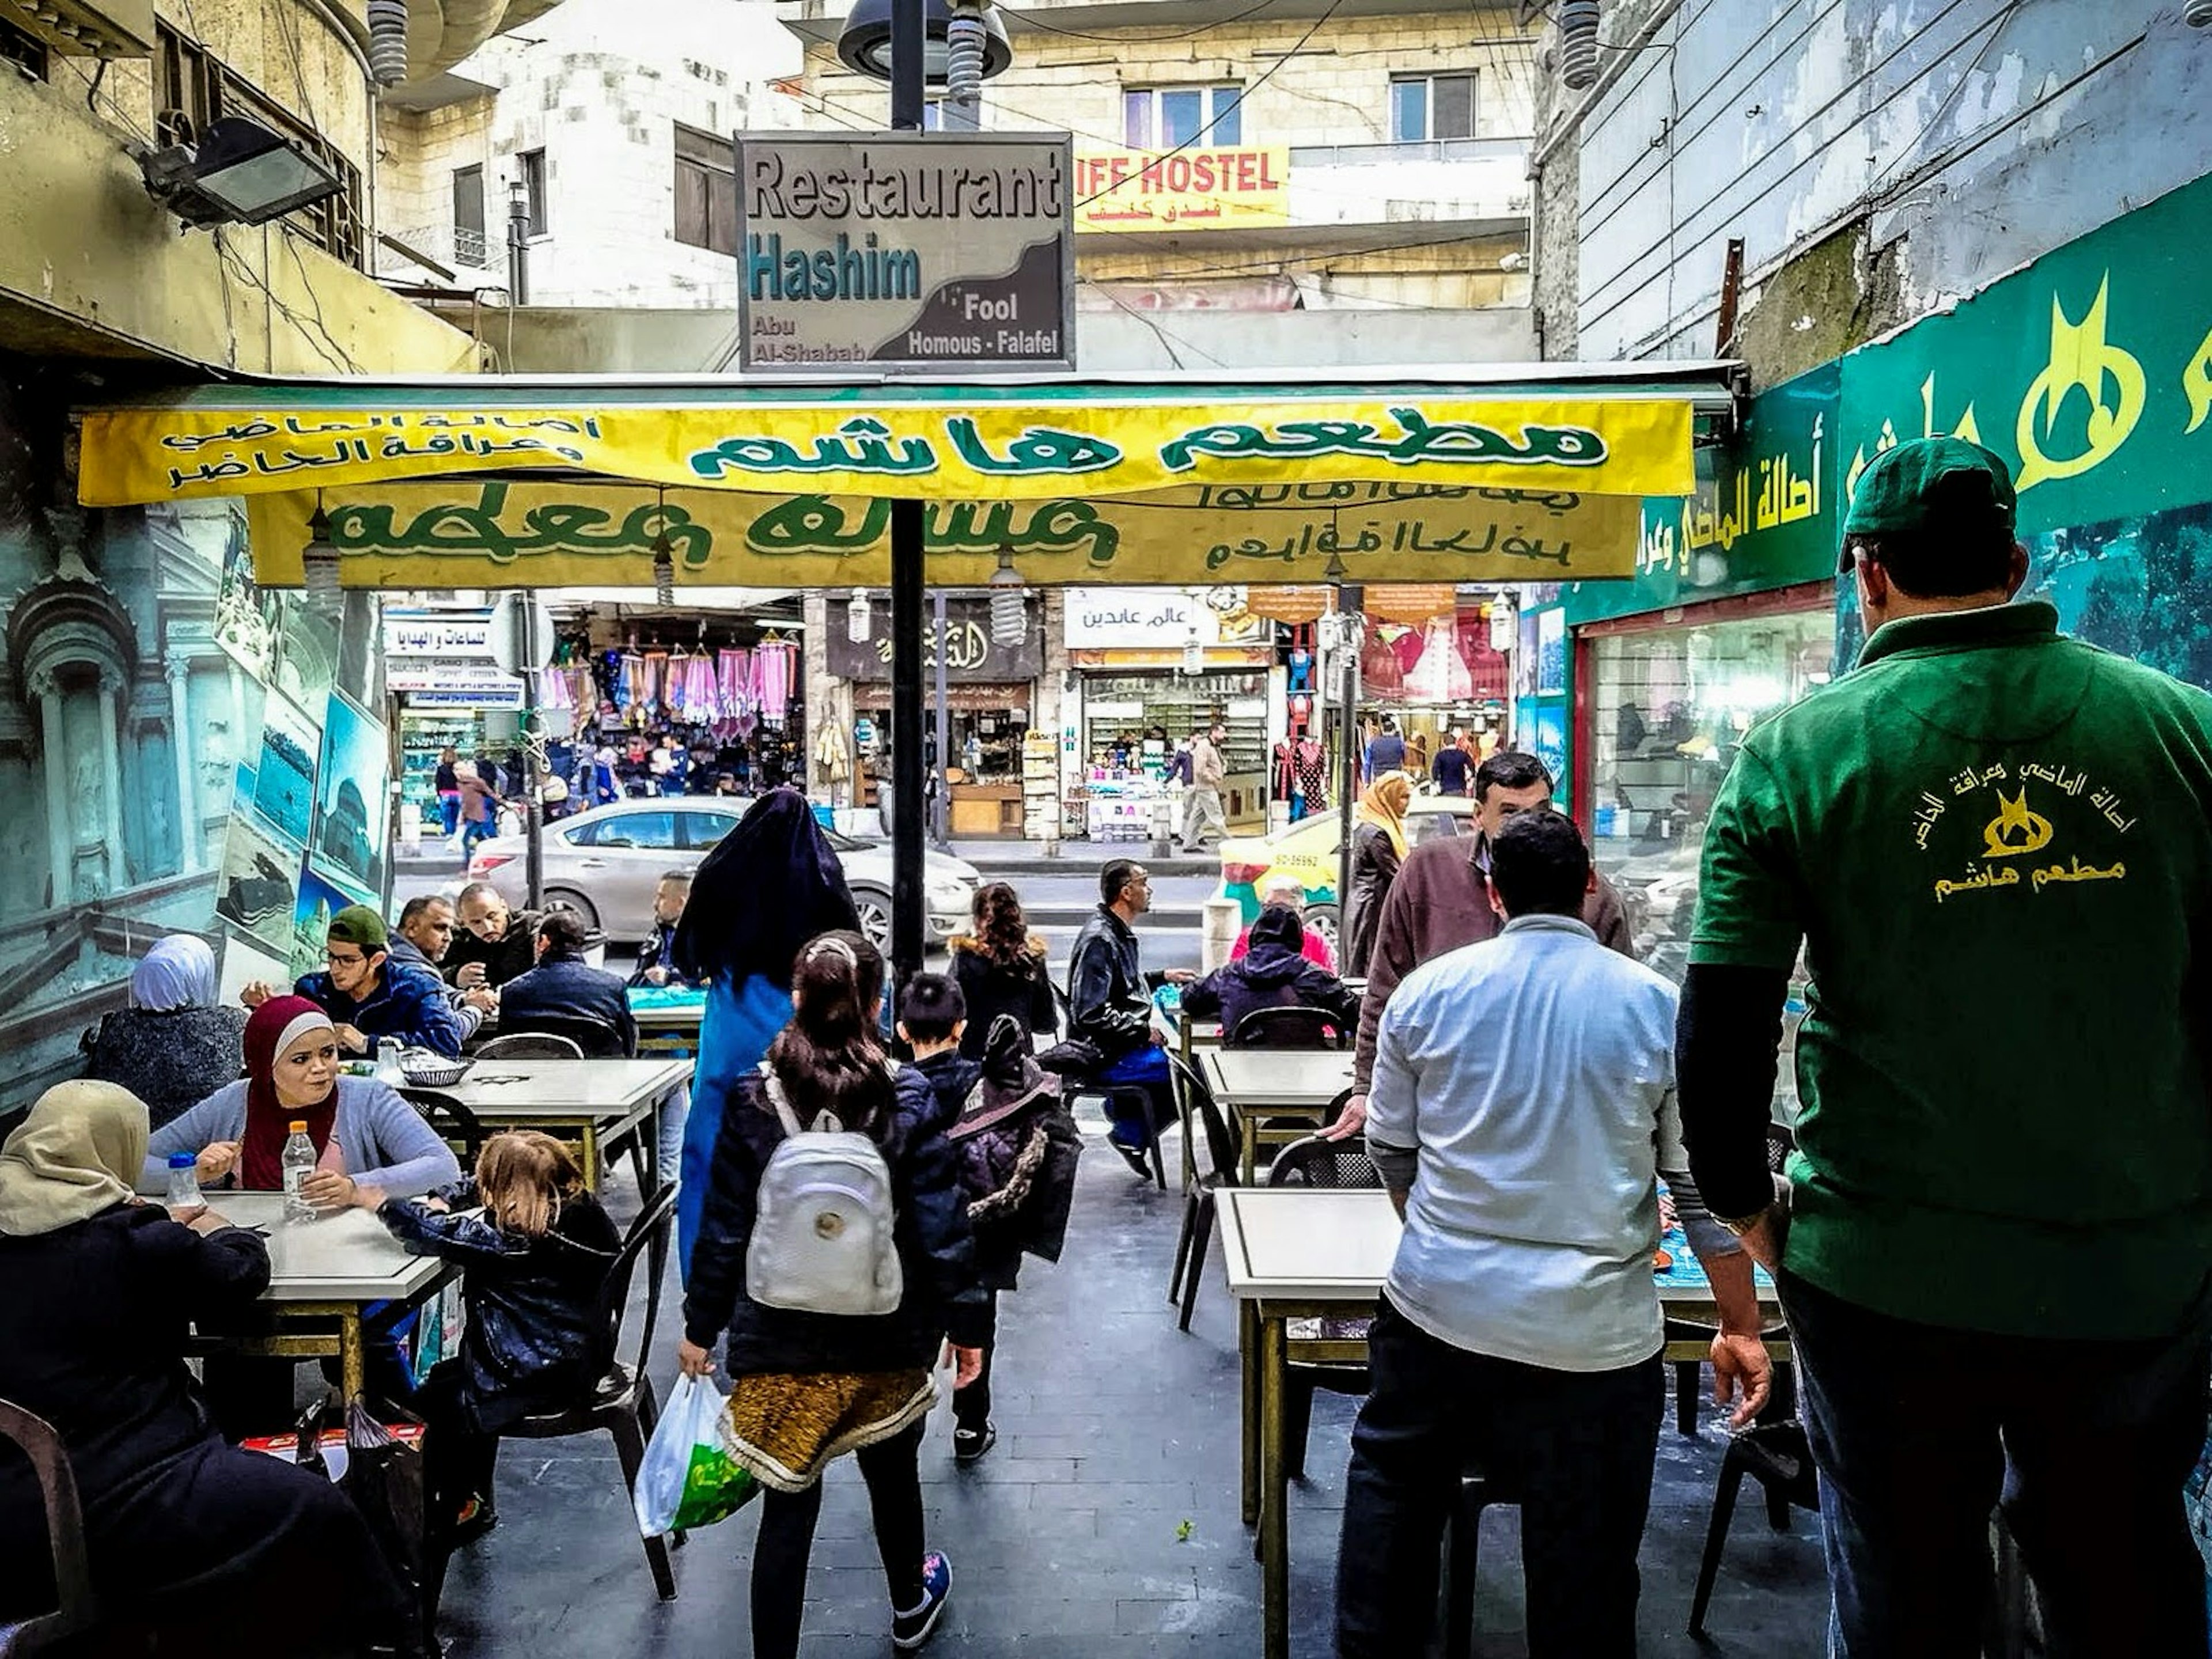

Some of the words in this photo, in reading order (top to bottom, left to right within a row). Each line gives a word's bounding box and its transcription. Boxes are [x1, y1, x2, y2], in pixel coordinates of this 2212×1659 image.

[748, 151, 1061, 219] Restaurant
[1141, 153, 1278, 194] HOSTEL
[748, 232, 921, 300] Hashim
[752, 316, 796, 335] Abu
[965, 293, 1017, 321] Fool
[908, 331, 981, 355] Homous
[998, 330, 1058, 355] Falafel
[162, 415, 404, 449] الماضي
[383, 433, 584, 463] وعراقة
[690, 416, 1124, 478] هاشم
[1160, 408, 1608, 471] مطعم
[167, 438, 372, 489] الحاضر
[1083, 608, 1141, 628] عابدين
[1147, 608, 1186, 627] عالم
[1949, 762, 2008, 796] وعراقة
[2019, 762, 2088, 796] الماضي
[1913, 790, 1945, 850] الحاضر
[1934, 861, 2020, 903] هاشم
[2031, 854, 2126, 894] مطعم
